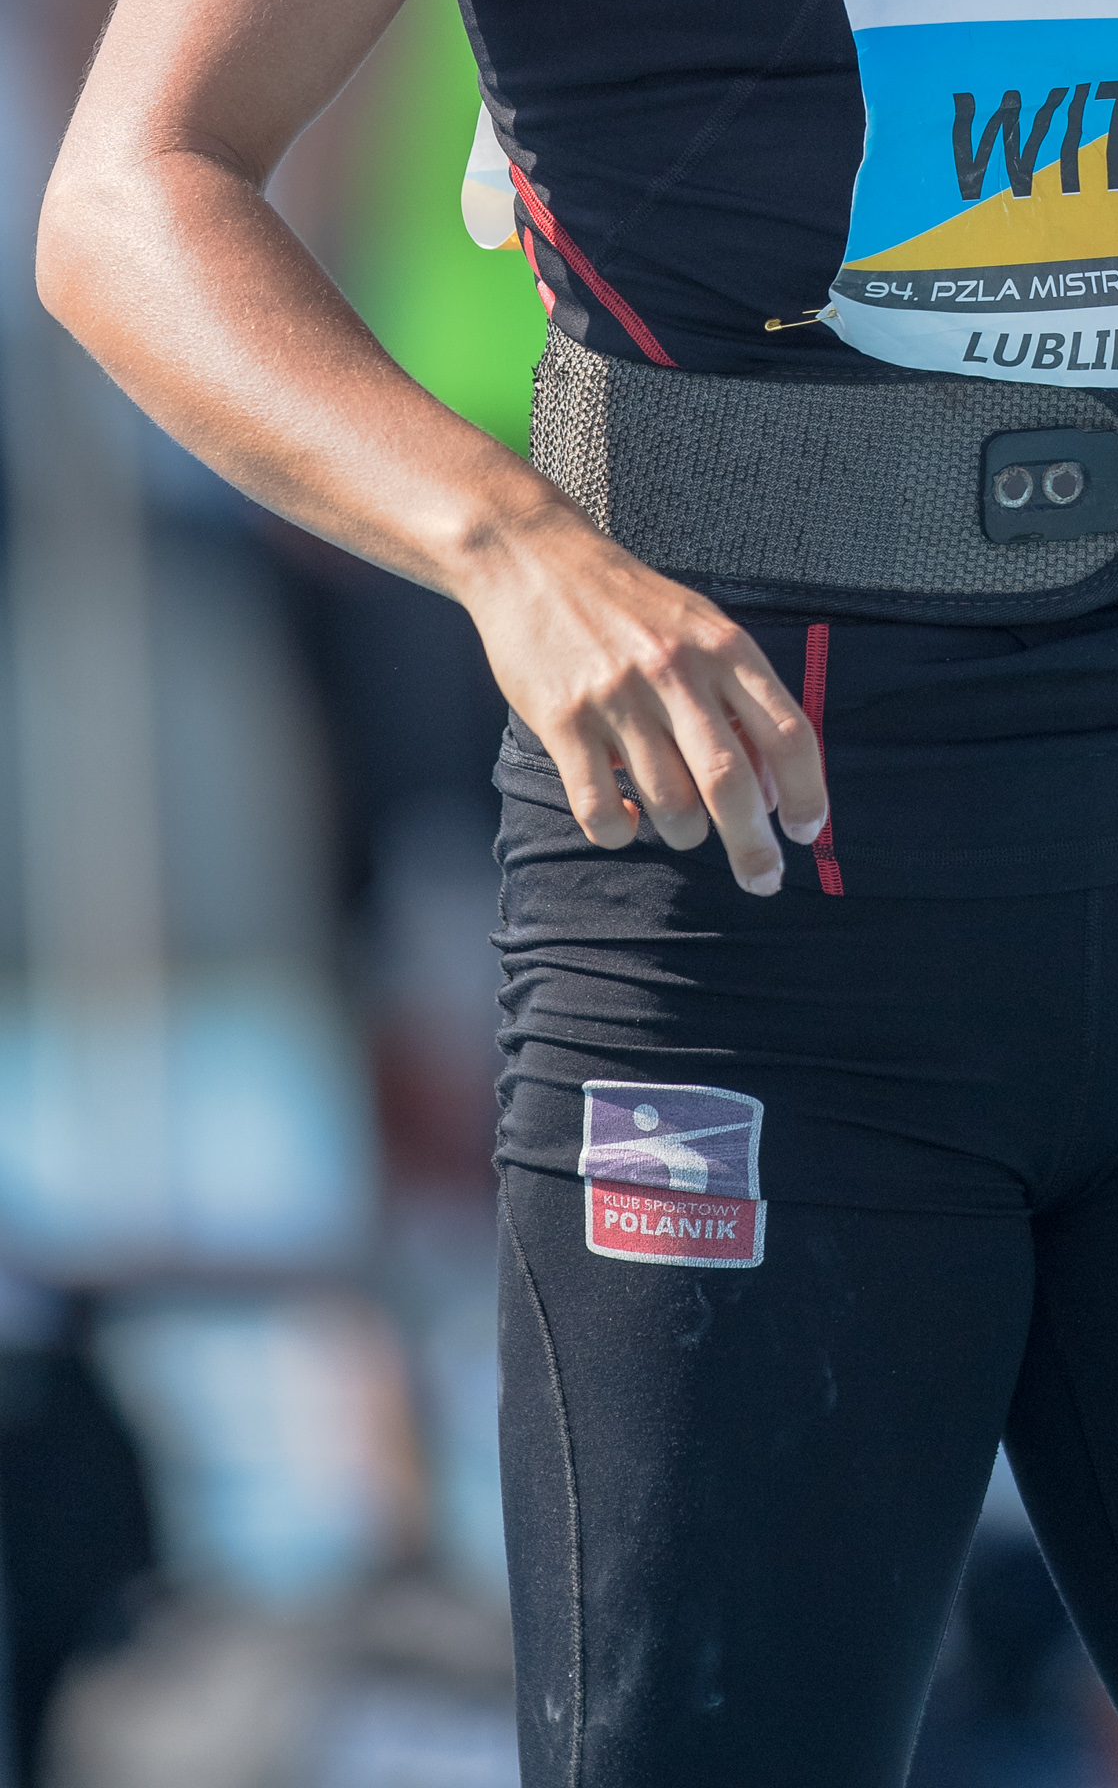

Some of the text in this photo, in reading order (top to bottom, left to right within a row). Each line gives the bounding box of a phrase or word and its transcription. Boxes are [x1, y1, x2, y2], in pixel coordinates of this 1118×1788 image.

[864, 281, 919, 302] 94.
[930, 277, 1021, 302] PZLA
[603, 1194, 741, 1217] KLUB SPORTOWY
[604, 1209, 739, 1240] POLANIK
